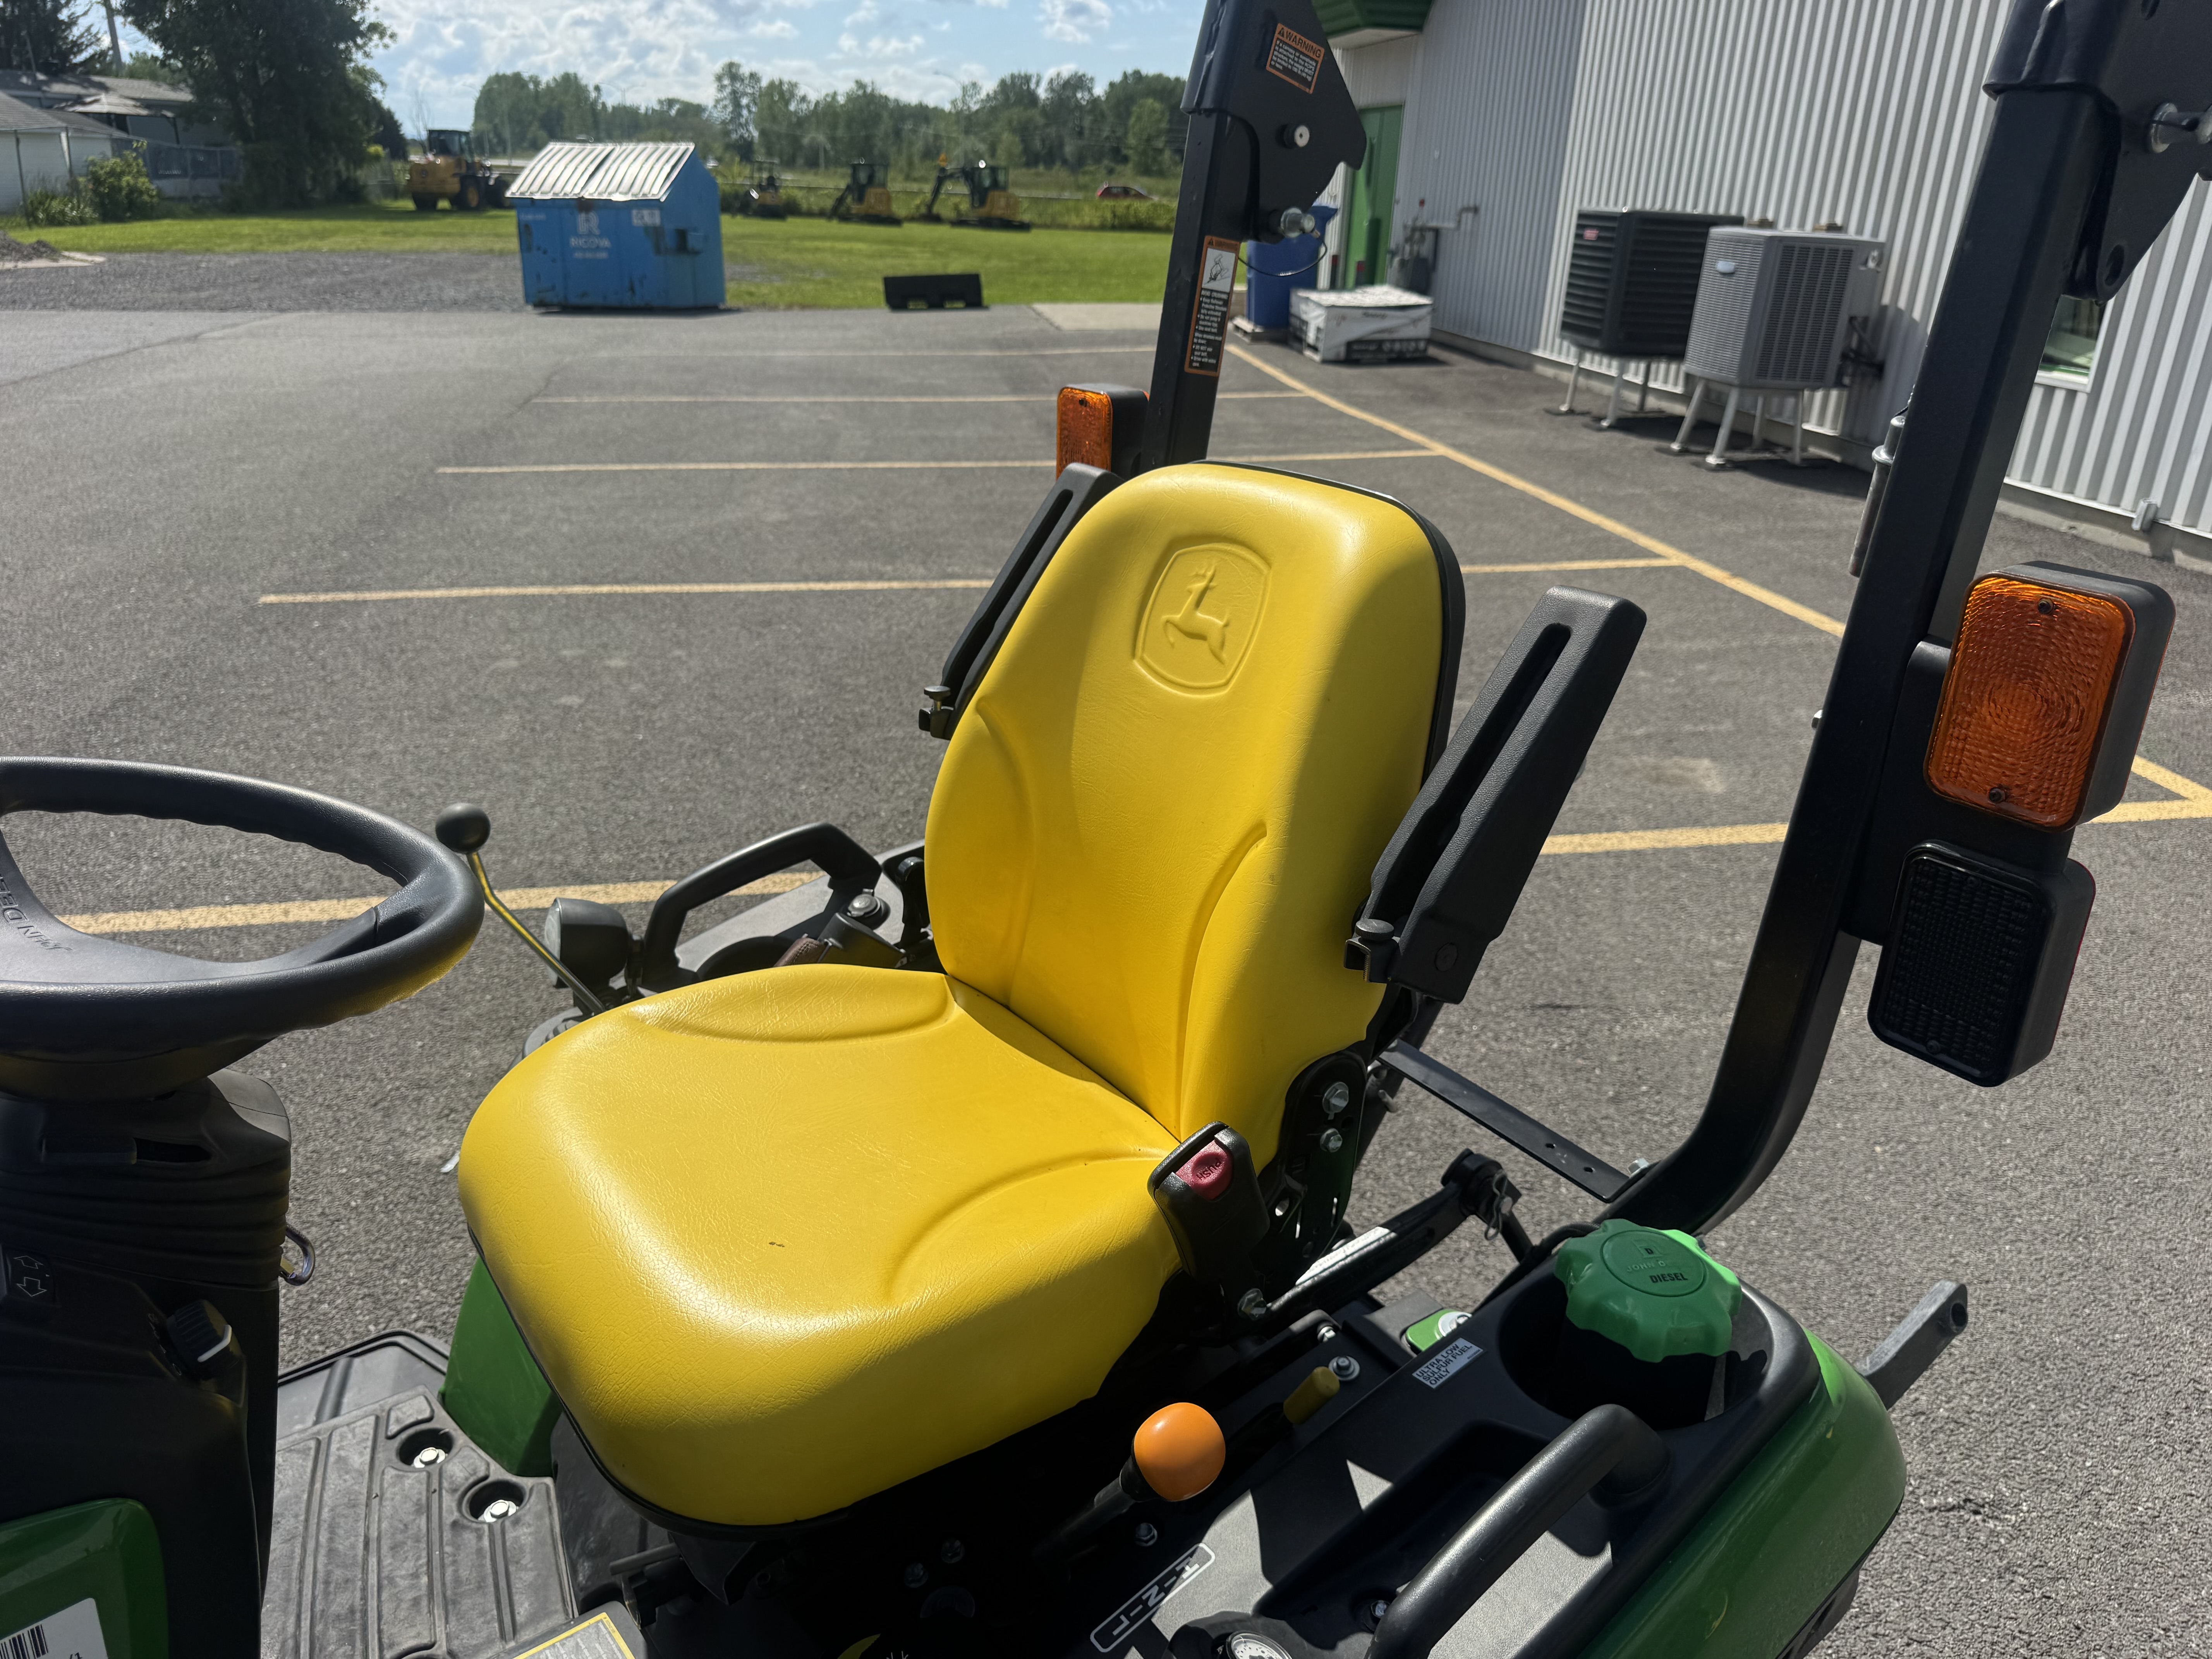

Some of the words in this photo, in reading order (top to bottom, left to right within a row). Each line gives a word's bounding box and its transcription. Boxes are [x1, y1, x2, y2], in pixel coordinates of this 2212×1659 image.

[1285, 30, 1321, 58] WARNING
[1196, 1158, 1222, 1180] PUSH
[1649, 1273, 1688, 1283] DIESEL
[1416, 1358, 1443, 1377] ULTRA
[1441, 1344, 1459, 1358] LOW
[1422, 1358, 1453, 1381] SULFUR
[1451, 1345, 1472, 1359] FUEL
[1429, 1368, 1450, 1385] ONLY
